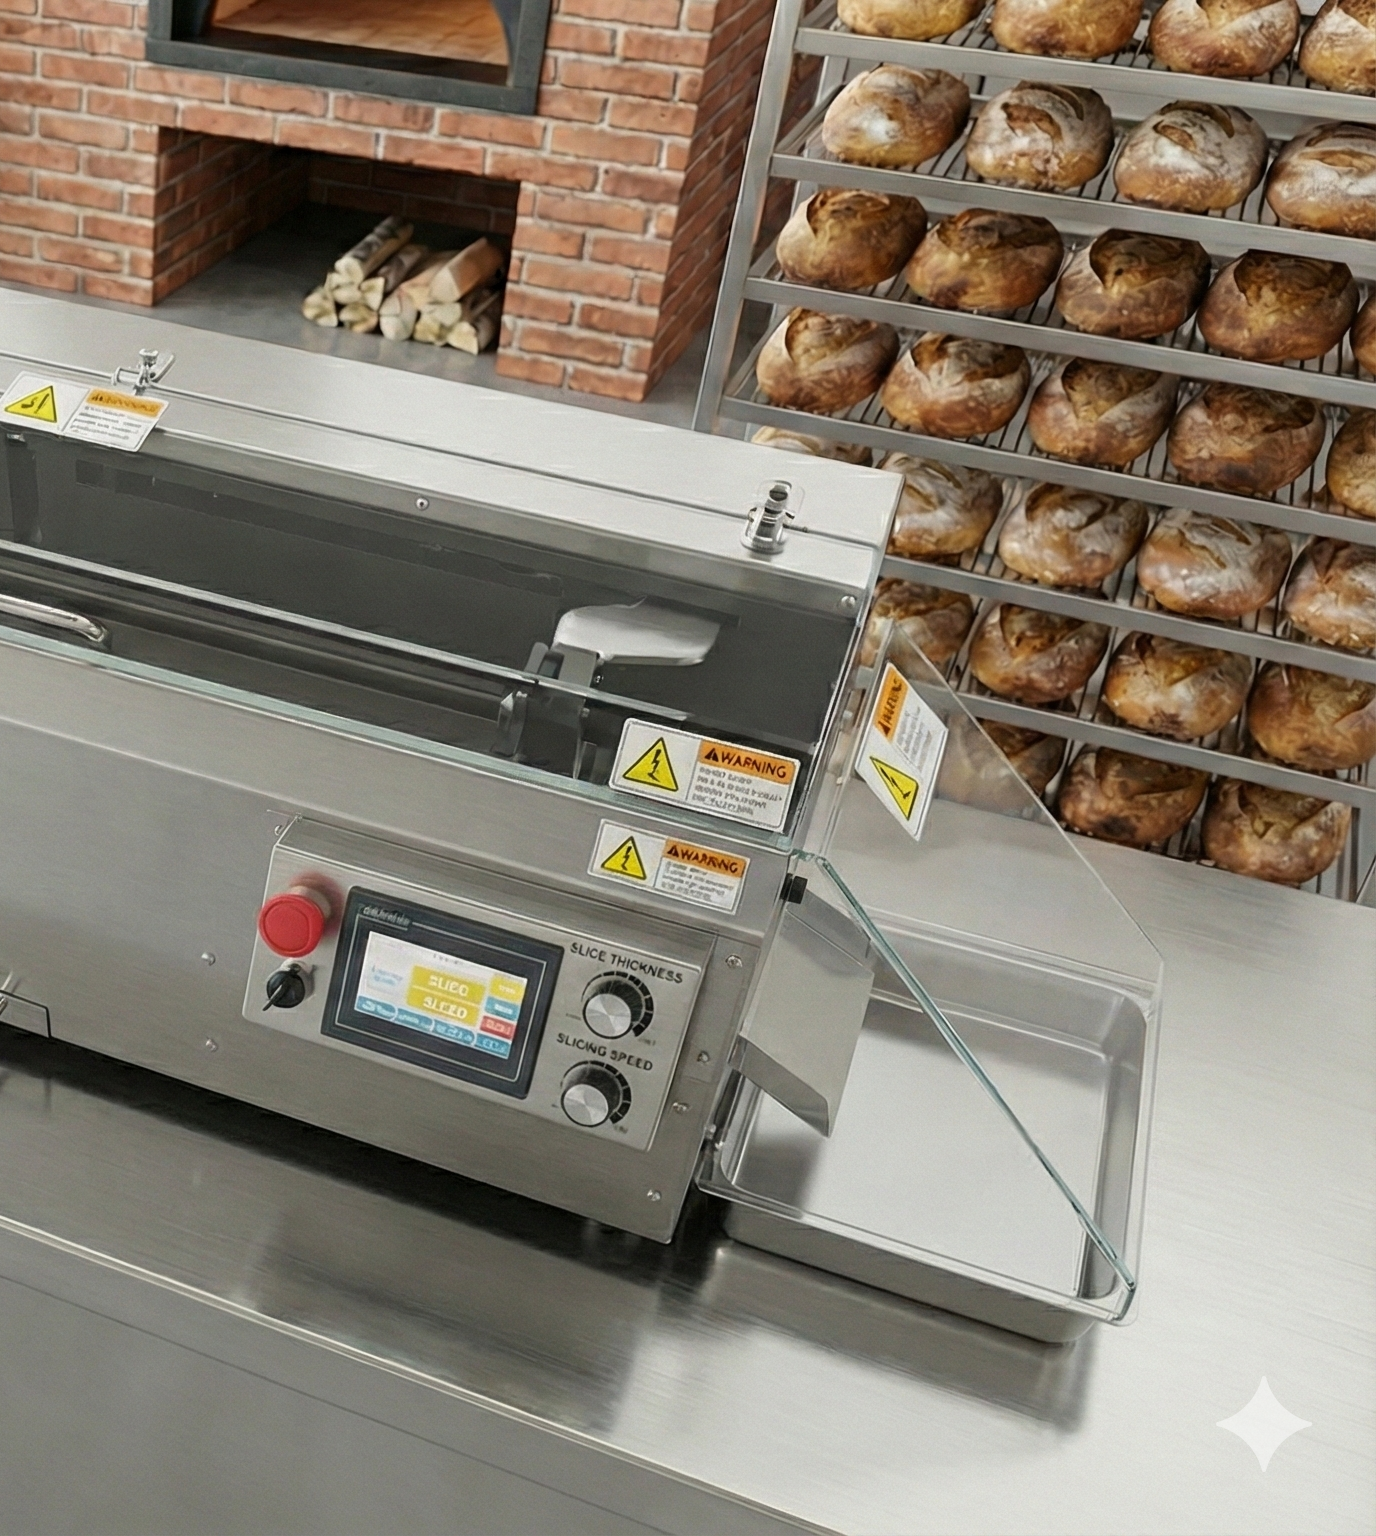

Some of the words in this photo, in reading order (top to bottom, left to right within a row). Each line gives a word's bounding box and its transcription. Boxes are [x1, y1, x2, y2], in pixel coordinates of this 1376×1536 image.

[721, 750, 787, 779] WARNING
[570, 942, 606, 963] SLICE
[610, 953, 684, 984] THICKNESS
[609, 1050, 654, 1072] SPEED
